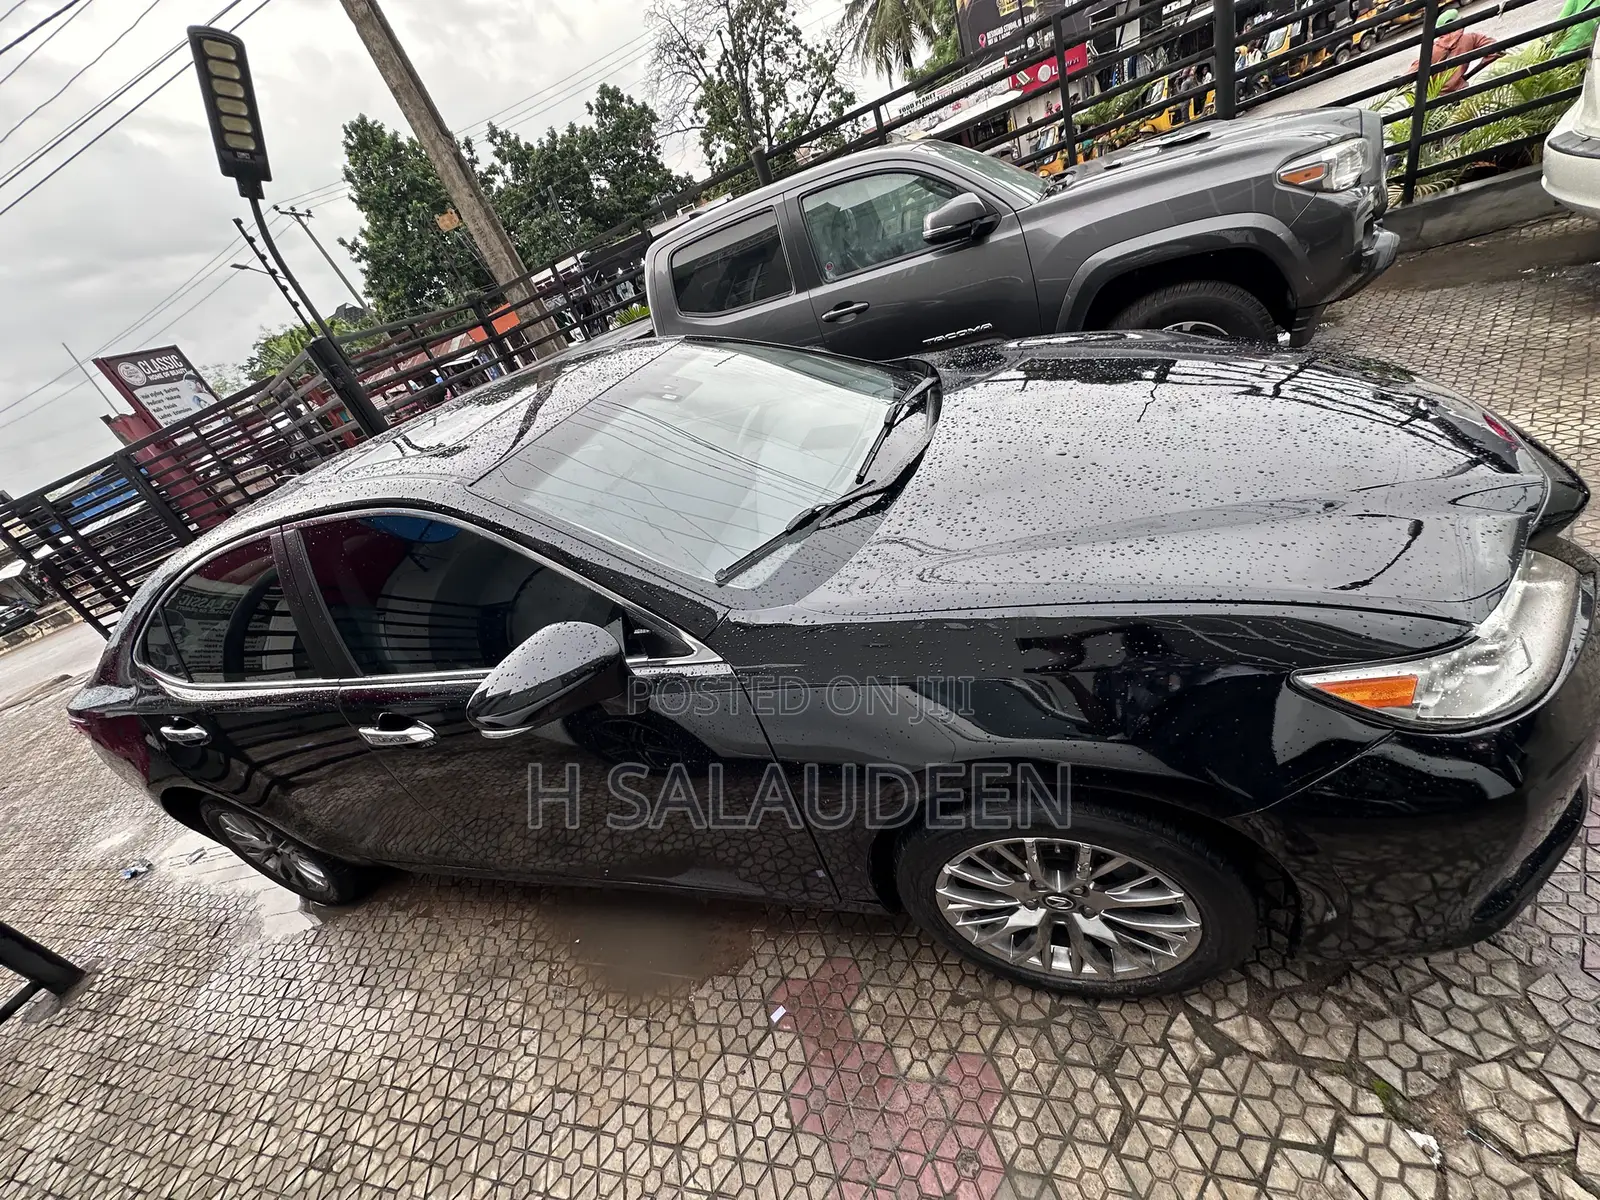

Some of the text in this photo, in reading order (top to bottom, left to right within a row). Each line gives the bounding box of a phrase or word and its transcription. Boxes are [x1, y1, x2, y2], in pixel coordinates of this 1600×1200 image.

[915, 92, 936, 106] PLANET
[922, 322, 993, 345] TACOMA
[137, 354, 184, 375] CLASSIC
[147, 373, 161, 381] HOME
[170, 367, 188, 377] BEAUTY
